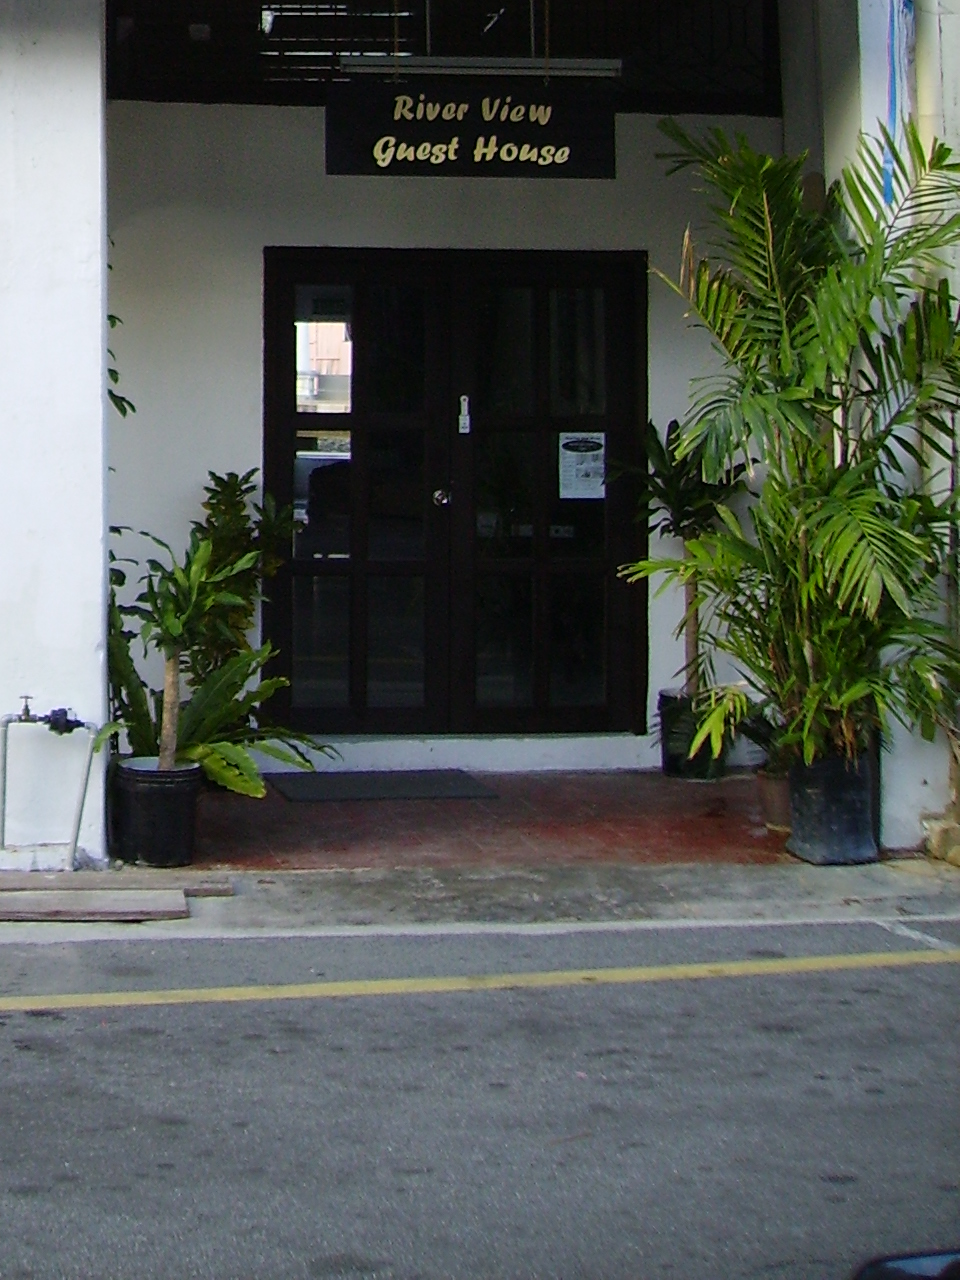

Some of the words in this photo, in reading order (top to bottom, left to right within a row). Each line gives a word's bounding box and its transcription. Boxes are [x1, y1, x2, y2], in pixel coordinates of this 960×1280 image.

[393, 93, 469, 121] River
[481, 95, 552, 126] View
[372, 135, 460, 168] Guest
[473, 134, 571, 166] House
